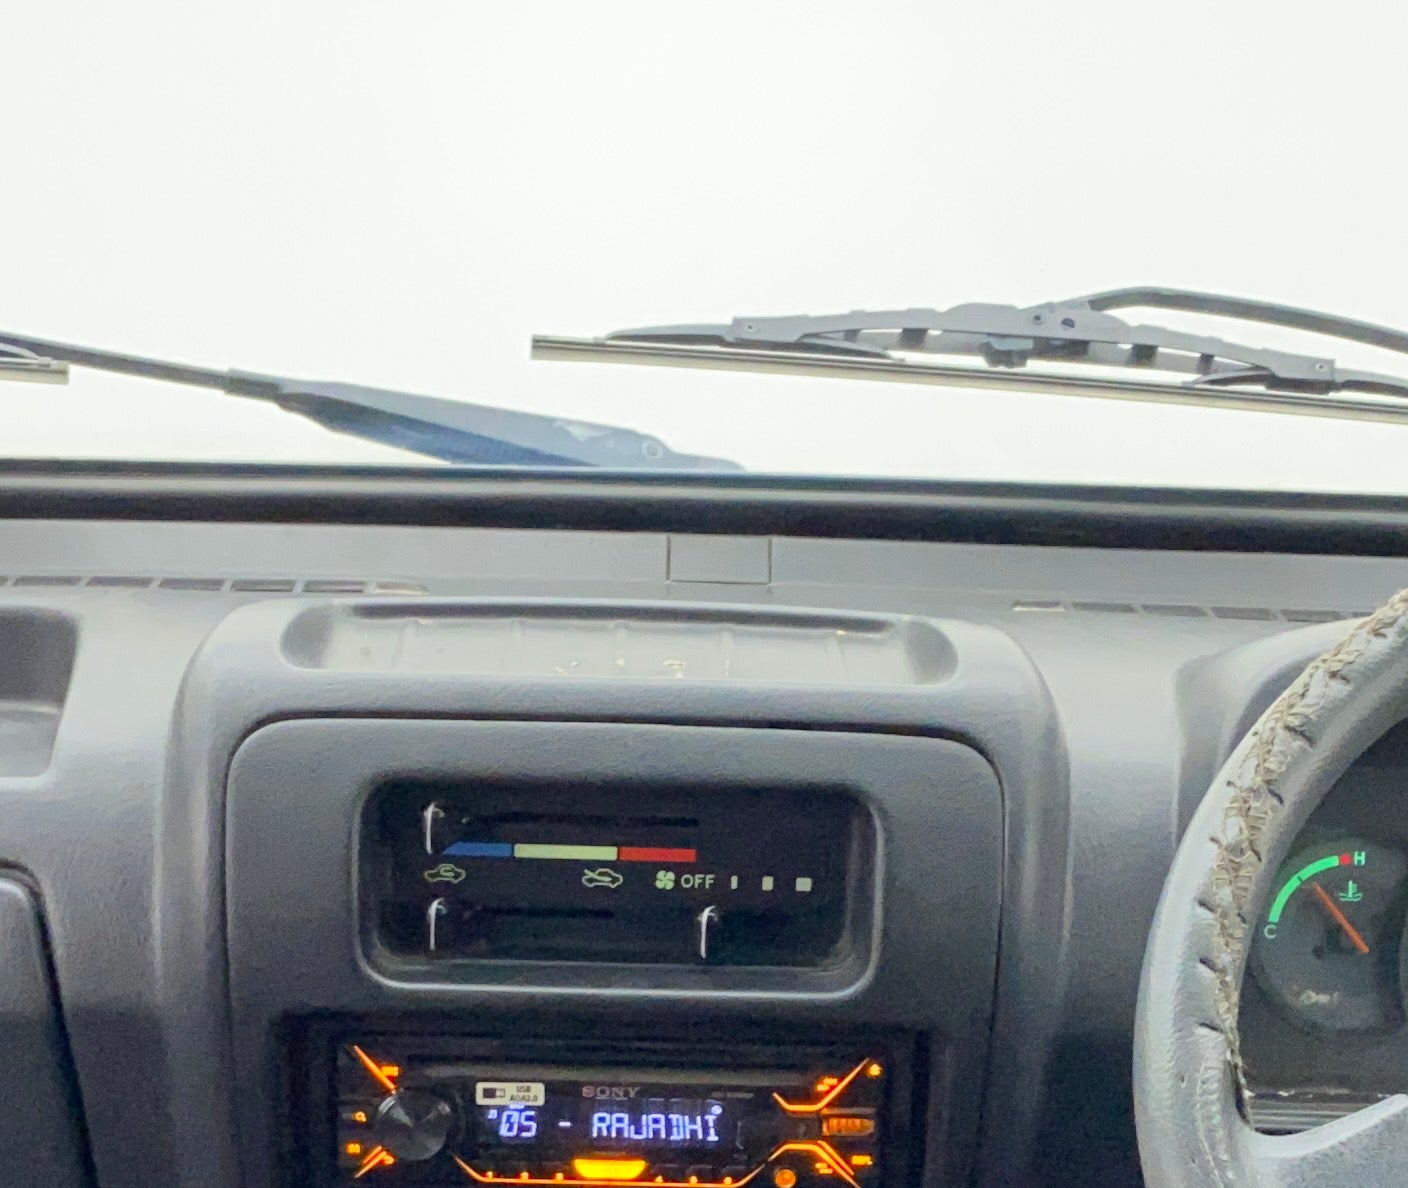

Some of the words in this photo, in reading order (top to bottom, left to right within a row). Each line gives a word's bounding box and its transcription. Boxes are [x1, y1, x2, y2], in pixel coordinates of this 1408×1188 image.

[1353, 851, 1366, 866] H
[680, 873, 716, 889] OFF
[1263, 924, 1278, 940] C
[581, 1085, 640, 1099] SONY
[592, 1111, 720, 1142] RAJADHI
